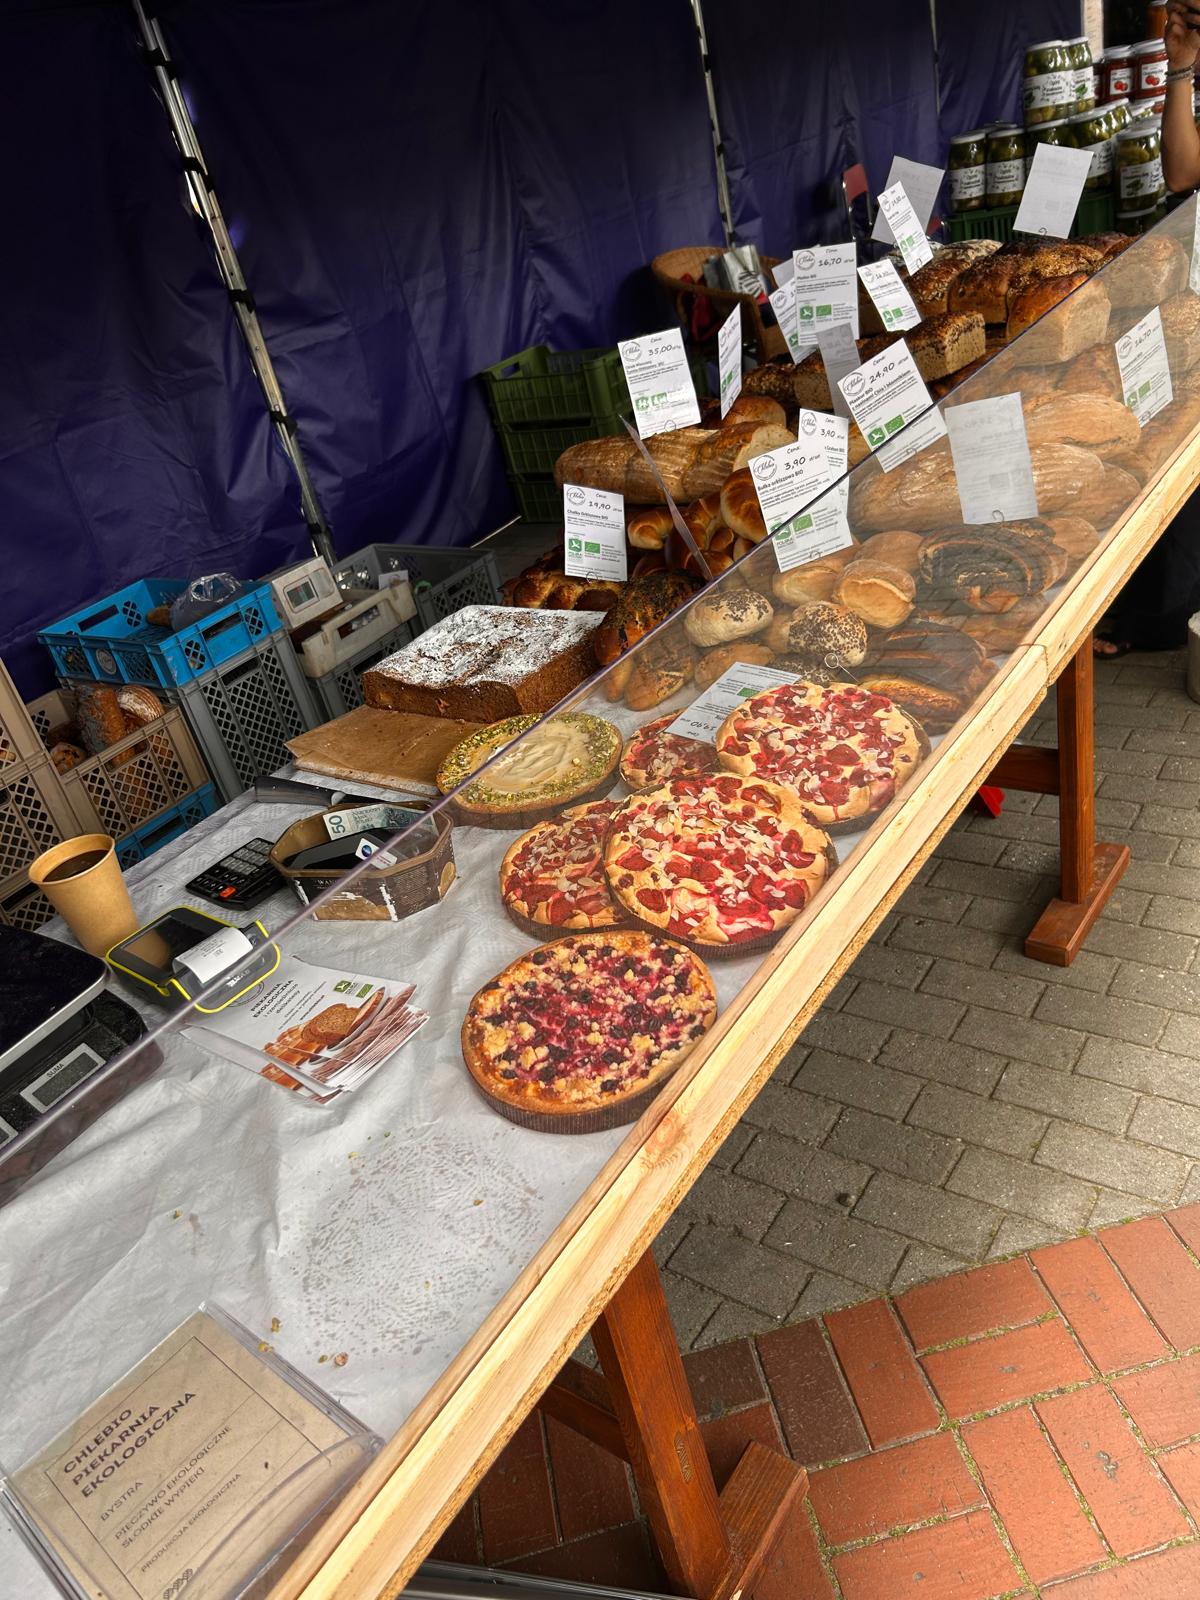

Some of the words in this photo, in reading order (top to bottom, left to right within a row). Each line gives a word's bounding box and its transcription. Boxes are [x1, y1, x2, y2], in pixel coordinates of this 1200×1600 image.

[648, 344, 673, 356] 35,00
[869, 362, 895, 384] 24,90
[820, 428, 836, 438] 3,90
[784, 456, 807, 471] 3,90
[794, 469, 804, 477] BIO
[588, 501, 611, 510] 19,90
[328, 814, 347, 835] 50
[250, 982, 283, 1012] PIEKARNIA
[252, 979, 295, 1018] EKOLOGICZNA
[46, 1063, 65, 1078] SUMA
[63, 1409, 132, 1474] CHLEBIO
[72, 1405, 160, 1485] PIEKARNIA
[81, 1392, 196, 1498] EKOLOGICZNA
[115, 1489, 167, 1540] PIECZYWO
[166, 1425, 232, 1491] EKOLOGICZNE
[164, 1466, 206, 1507] WYPIEKI
[100, 1481, 143, 1521] BYSTRA
[188, 1473, 241, 1527] EKOLOGICZNA
